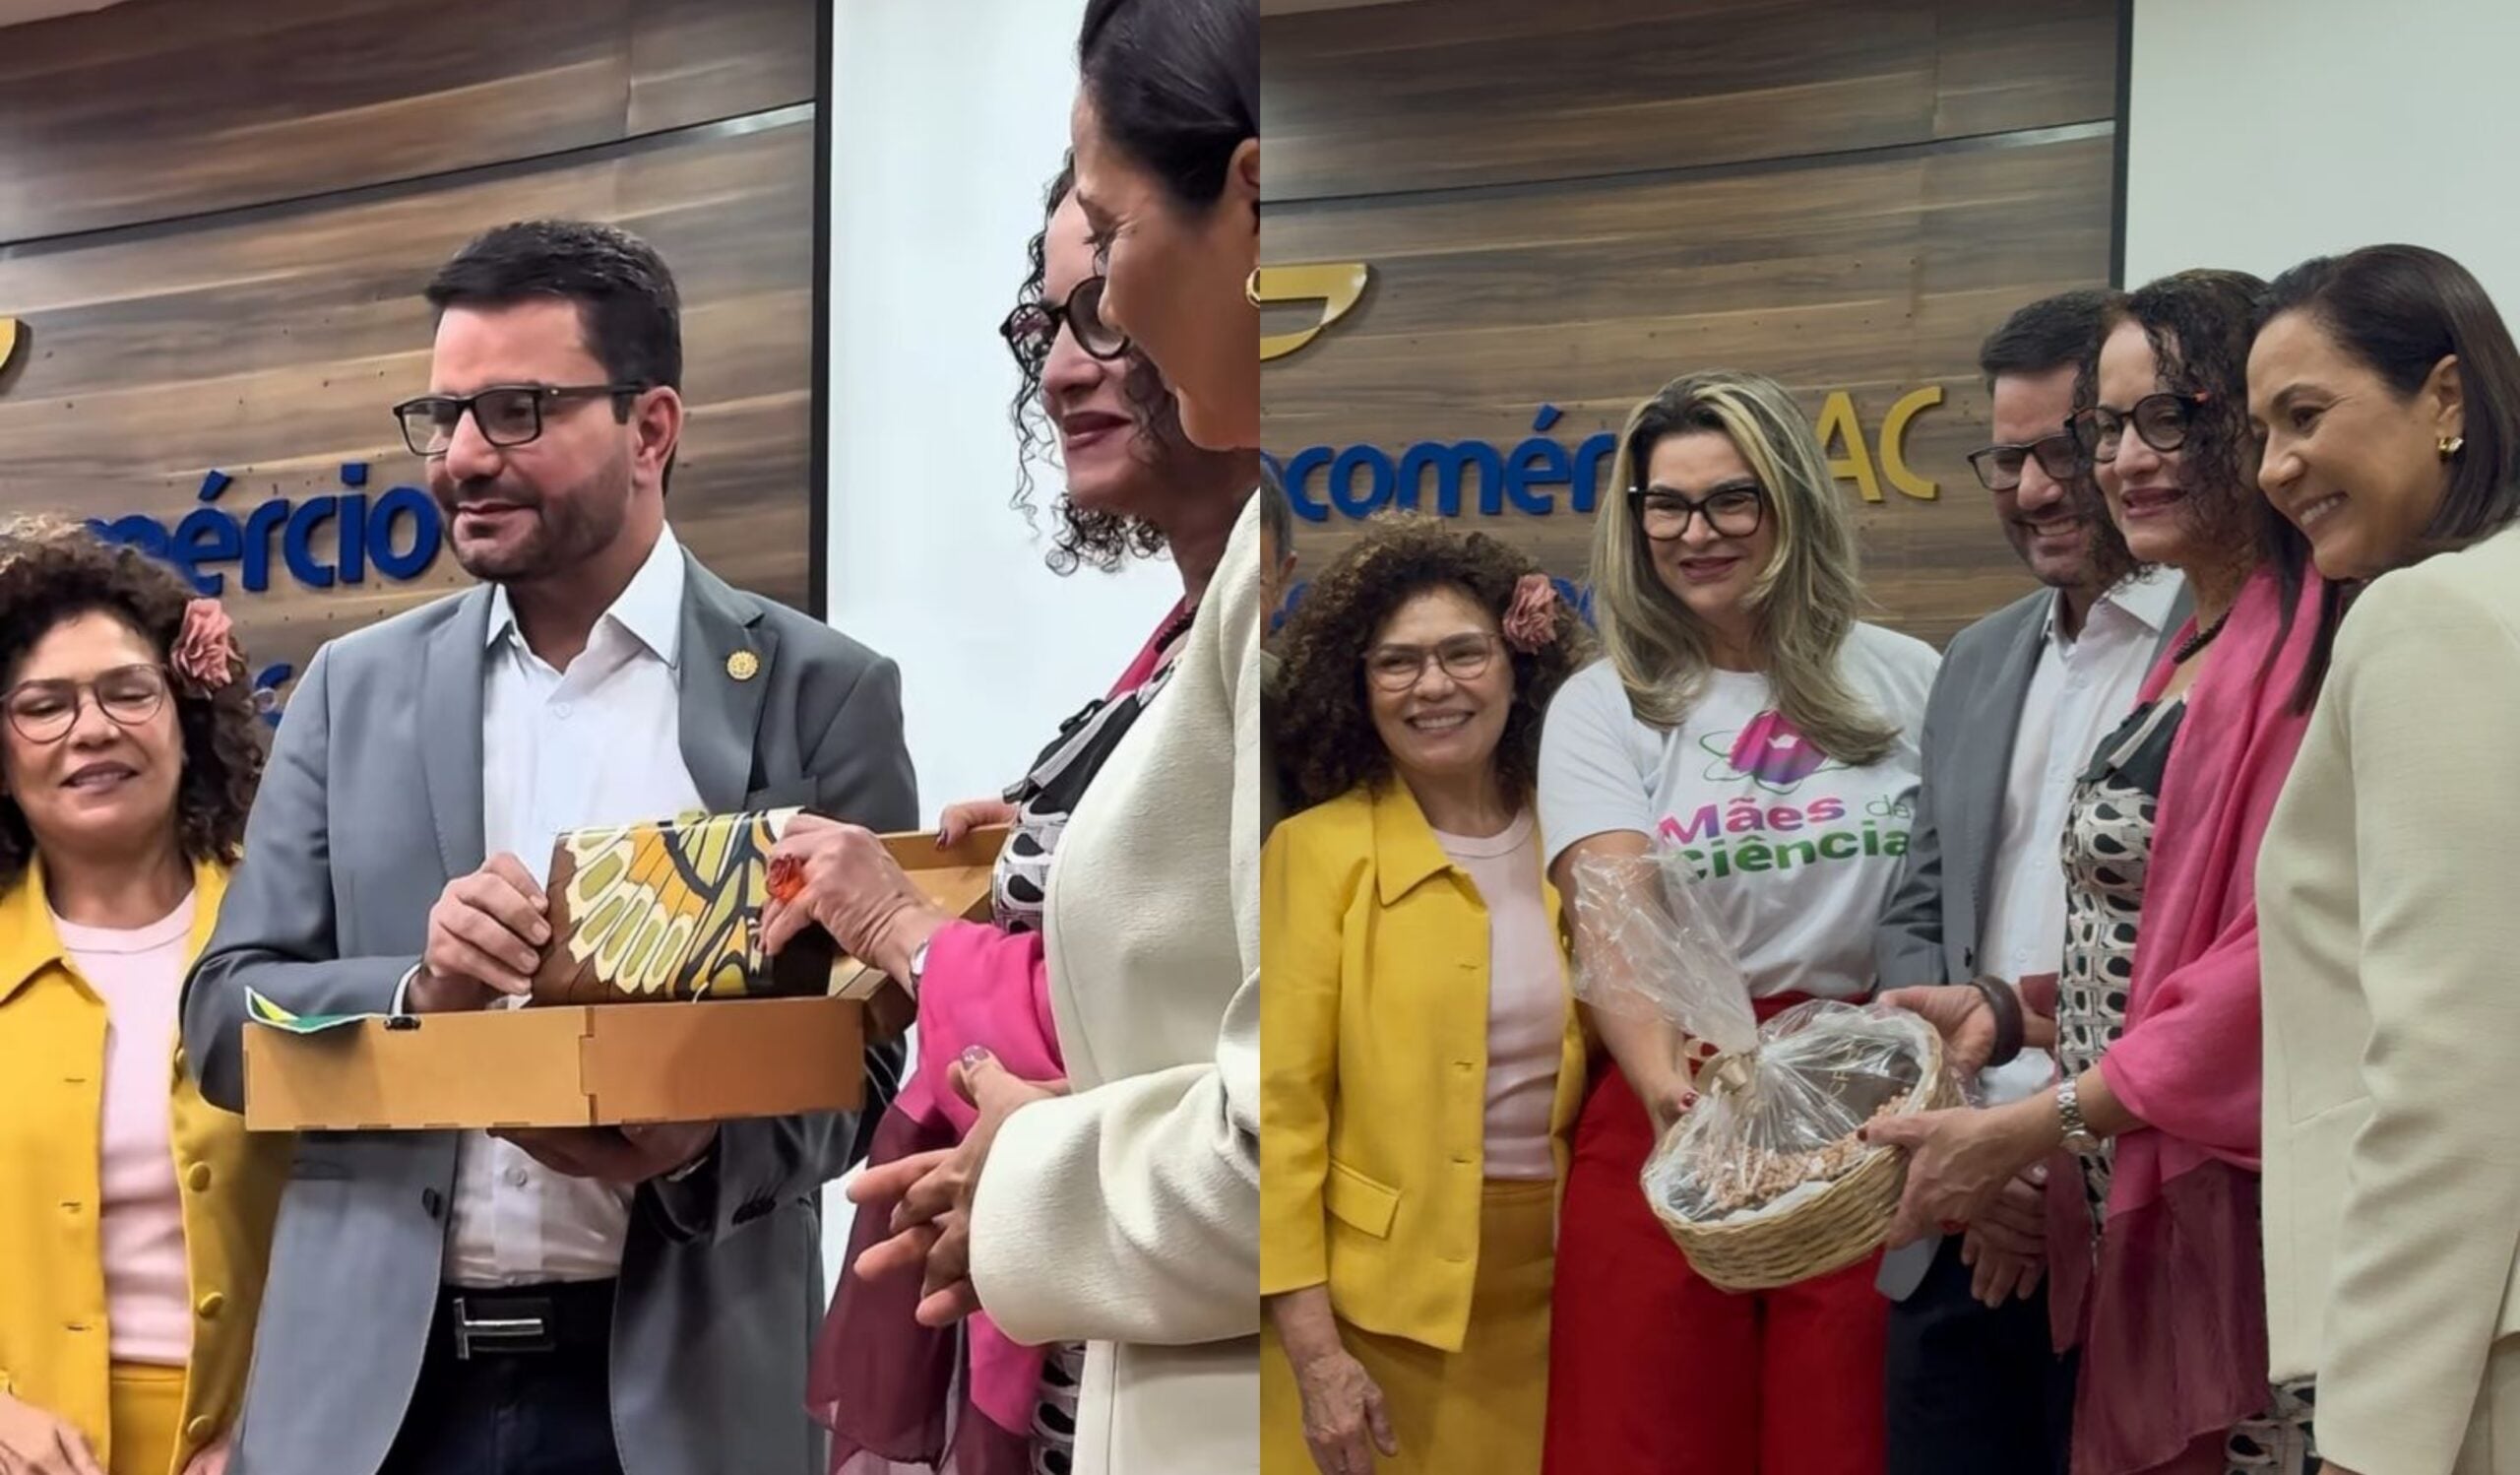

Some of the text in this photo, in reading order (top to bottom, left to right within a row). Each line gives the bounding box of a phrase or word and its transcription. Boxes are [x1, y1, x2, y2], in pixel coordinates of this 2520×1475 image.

[1261, 385, 1941, 522] comér AC
[1659, 797, 1846, 845] Mães
